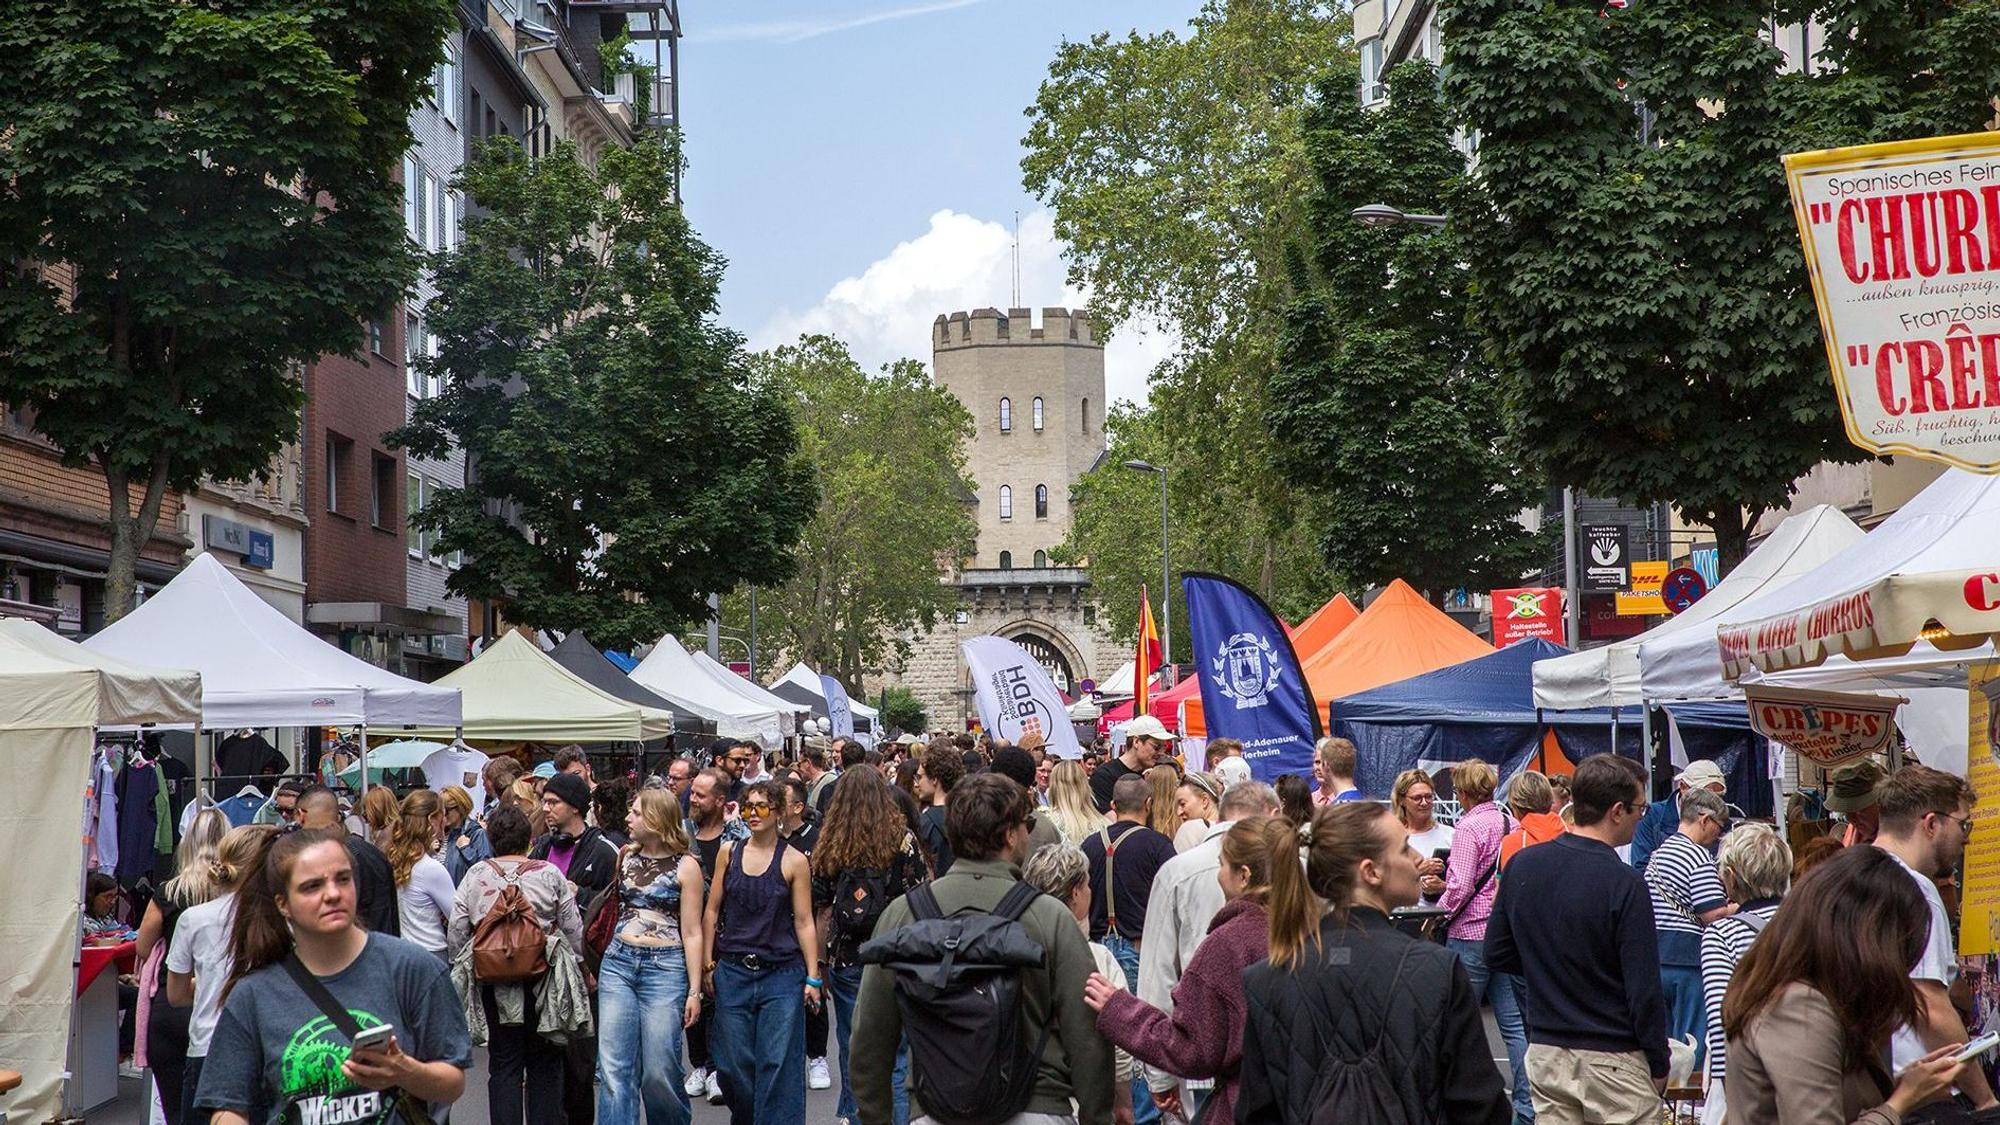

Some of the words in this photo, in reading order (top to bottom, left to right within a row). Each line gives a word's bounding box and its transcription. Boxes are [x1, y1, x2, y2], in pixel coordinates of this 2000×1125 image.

[1828, 169, 1952, 198] Spanisches
[1621, 589, 1663, 598] PAKETSHO
[1510, 621, 1548, 631] Haltestelle
[1756, 613, 1799, 655] KAFFEE
[1807, 590, 1875, 642] CHURROS
